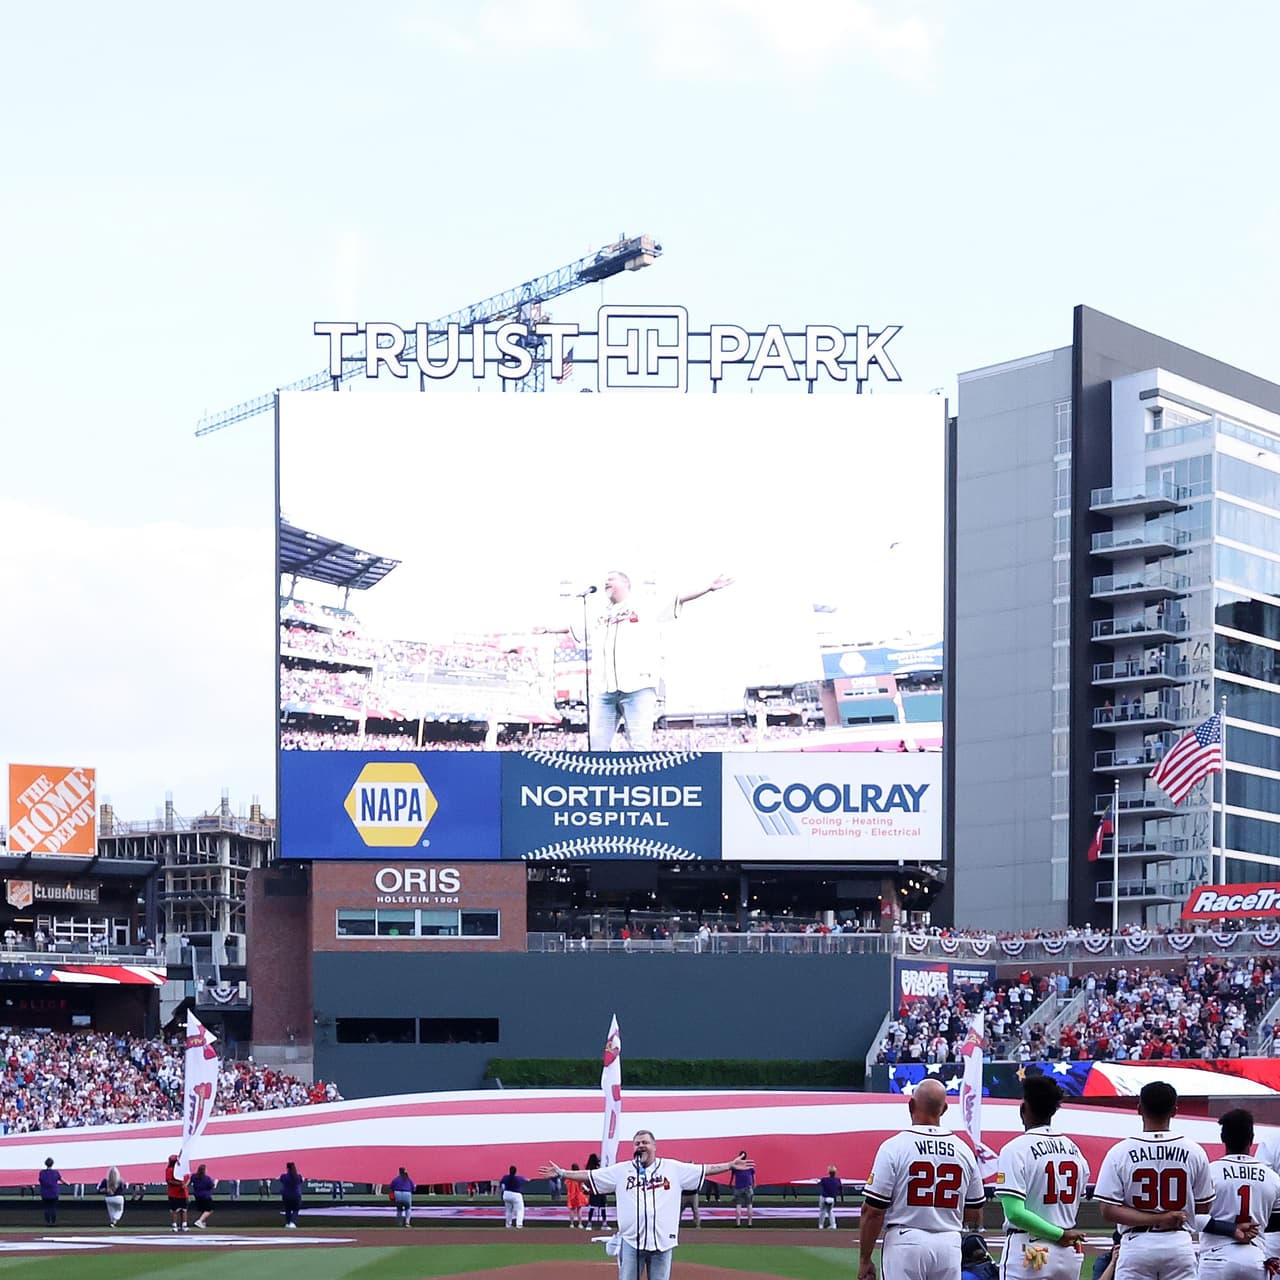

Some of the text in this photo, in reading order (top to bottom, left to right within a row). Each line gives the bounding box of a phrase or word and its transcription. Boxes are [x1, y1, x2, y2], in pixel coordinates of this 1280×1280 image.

[314, 322, 904, 381] TRUIST PARK
[16, 774, 54, 809] THE
[361, 787, 423, 822] NAPA
[521, 785, 703, 808] NORTHSIDE
[753, 783, 930, 813] COOLRAY
[9, 767, 96, 852] HOME
[554, 812, 669, 827] HOSPITAL
[801, 817, 893, 827] Cooling Heating
[42, 800, 96, 853] DEPOT
[811, 828, 921, 838] Plumbing Electrical
[34, 886, 97, 901] CLUBHOUSE
[375, 867, 461, 894] ORIS
[376, 896, 429, 904] HOLSTEIN
[901, 970, 948, 984] BRAVES
[914, 1141, 956, 1157] WEISS
[1129, 1148, 1189, 1165] BALDWIN
[907, 1161, 963, 1209] 22
[1044, 1160, 1078, 1204] 13
[1223, 1166, 1266, 1182] ALBIES
[1132, 1168, 1187, 1211] 30
[1235, 1184, 1252, 1224] 1
